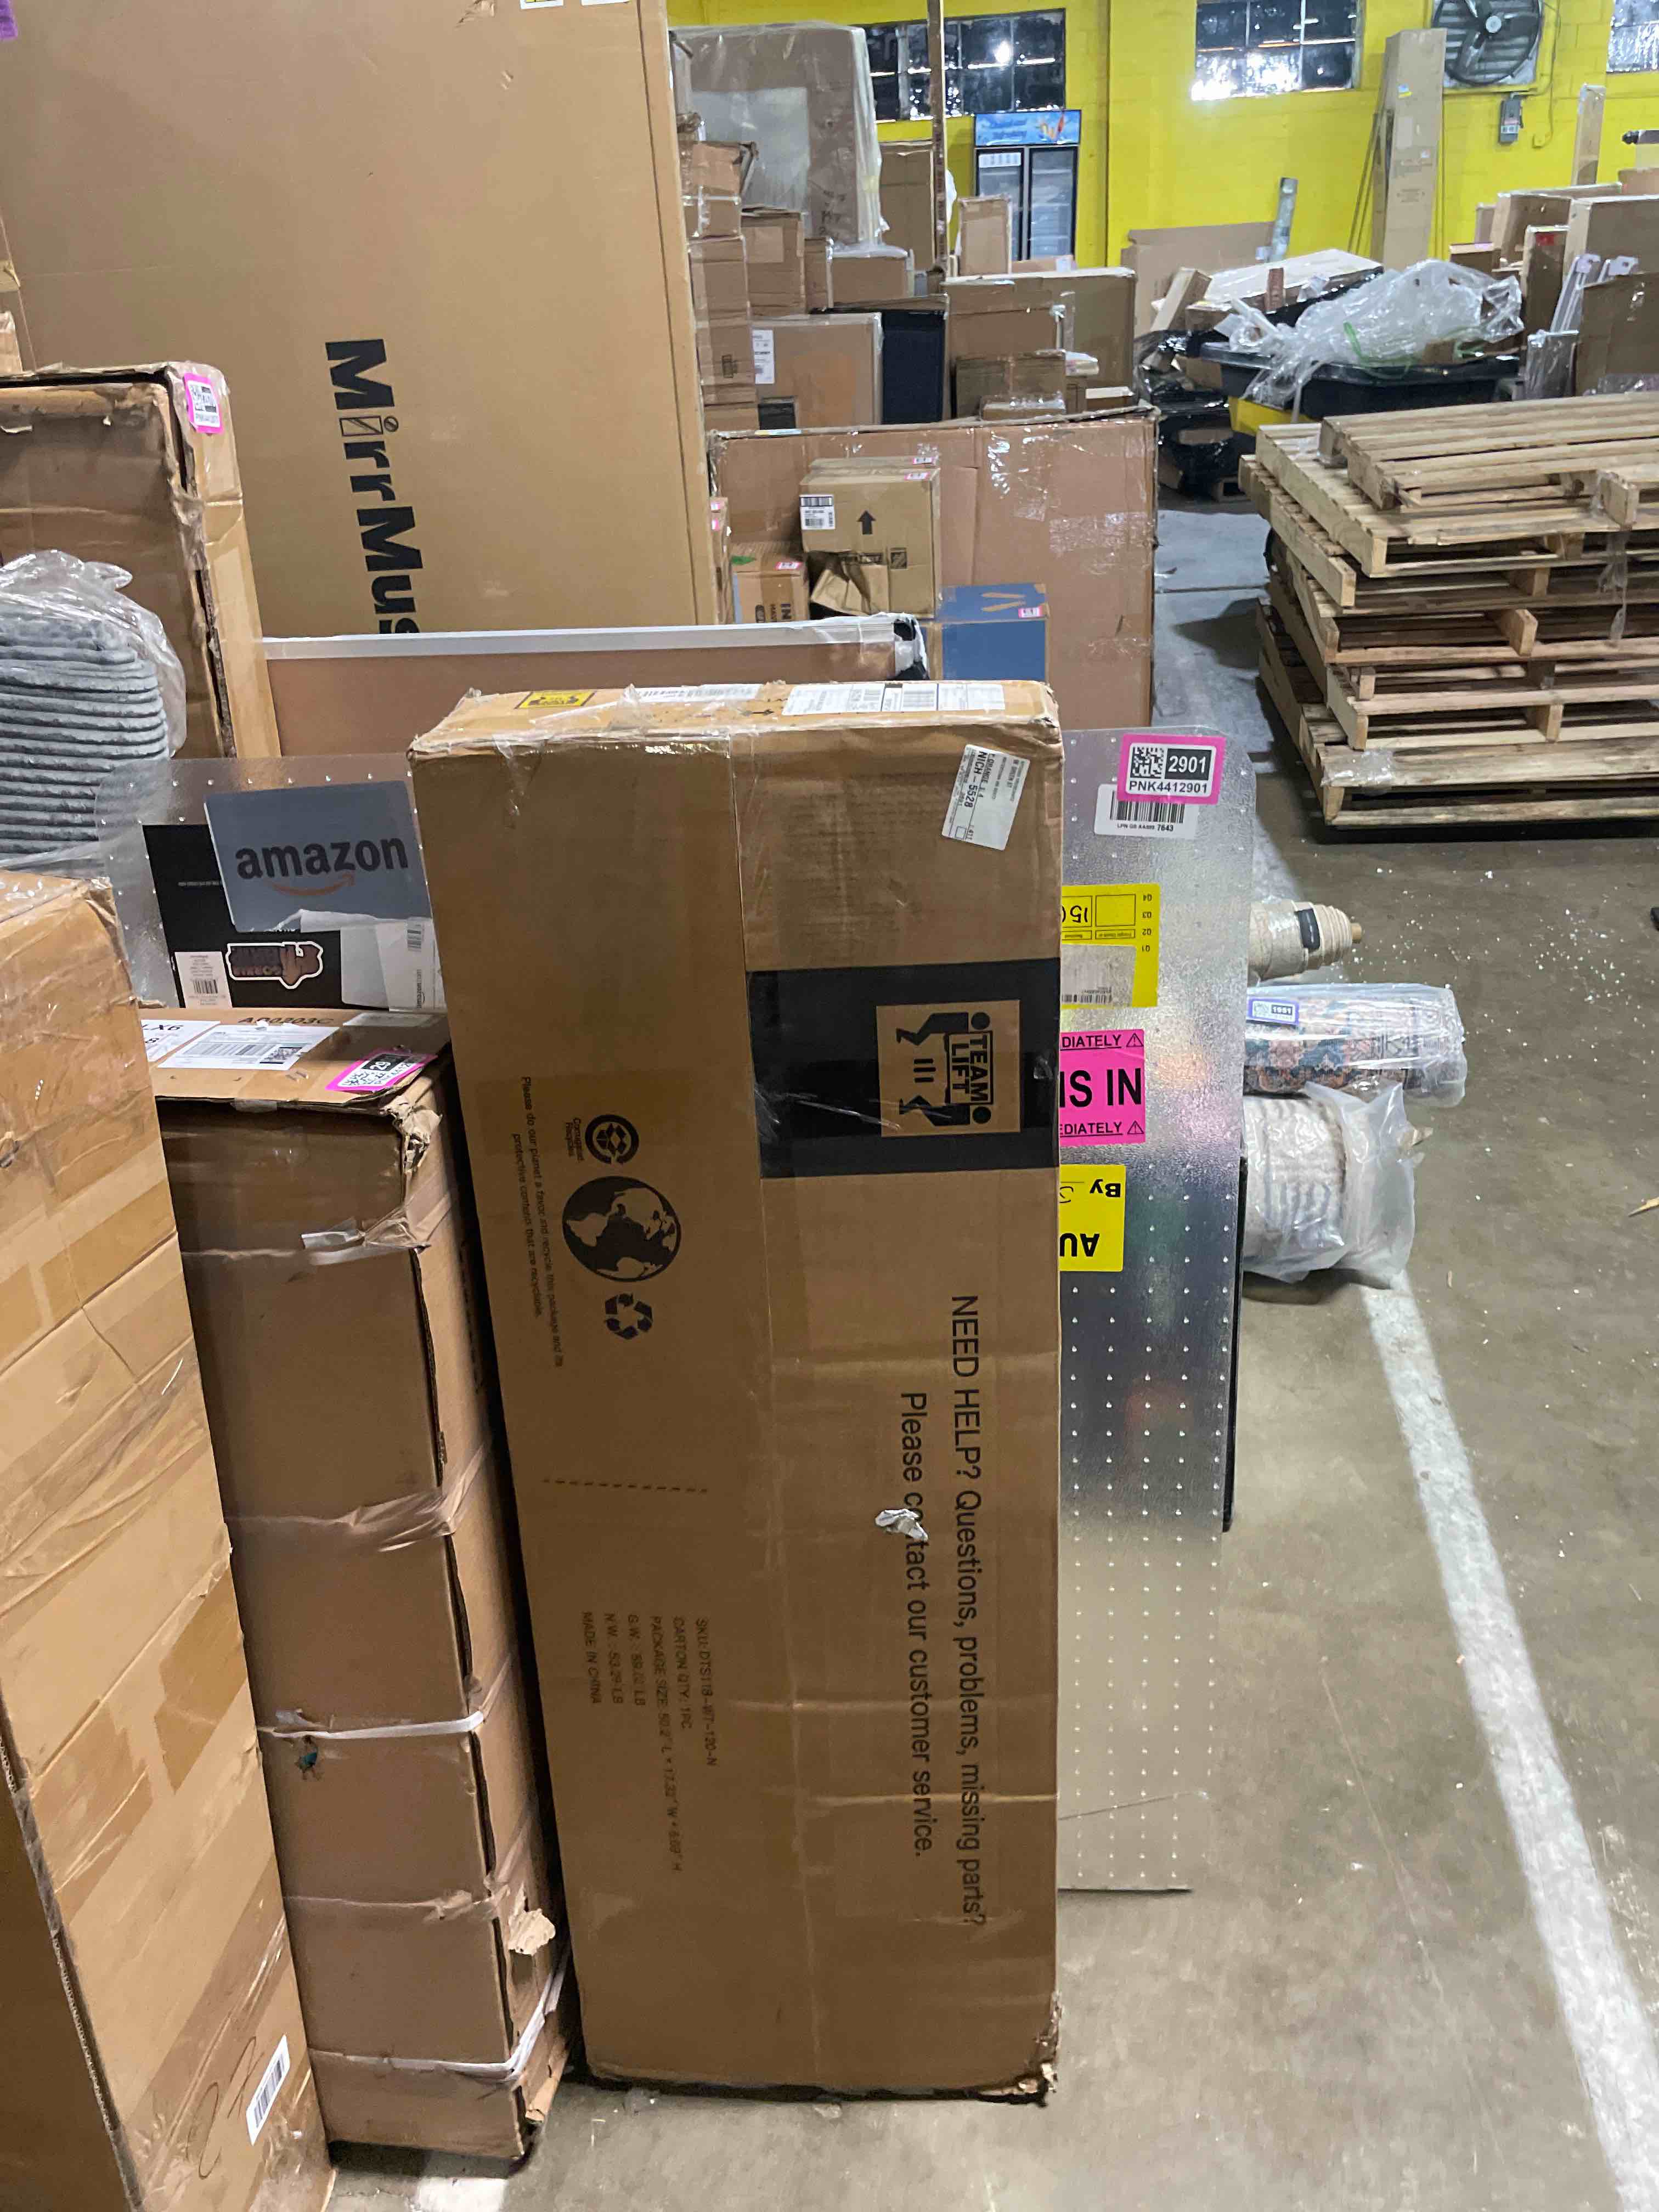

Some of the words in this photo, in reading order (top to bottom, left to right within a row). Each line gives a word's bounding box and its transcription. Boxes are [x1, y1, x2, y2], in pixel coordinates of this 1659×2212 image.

[973, 751, 989, 775] NICH
[1128, 780, 1207, 793] PNK4412901
[1167, 755, 1206, 773] 2901
[963, 784, 978, 808] 5528
[235, 837, 408, 879] amazon
[1062, 1034, 1122, 1048] DIATELY
[951, 1043, 970, 1094] LIFT
[969, 1034, 989, 1102] TEAM
[1107, 1068, 1142, 1106] IN
[1089, 1178, 1121, 1198] By
[1059, 1233, 1100, 1257] AU
[951, 1295, 979, 1378] NEED
[901, 1392, 928, 1482] Please
[953, 1389, 981, 1480] HELP?
[903, 1492, 930, 1590] cotact
[953, 1490, 983, 1628] Questions,
[582, 1612, 596, 1646] MADE
[650, 1616, 666, 1675] PACKAGE
[673, 1616, 687, 1668] CARTON
[907, 1599, 927, 1641] our
[586, 1650, 597, 1664] IN
[588, 1667, 601, 1703] CHINA
[909, 1649, 933, 1762] customer
[952, 1636, 984, 1756] problems,
[913, 1770, 938, 1857] service.
[956, 1764, 985, 1850] missing
[956, 1859, 986, 1926] parts?
